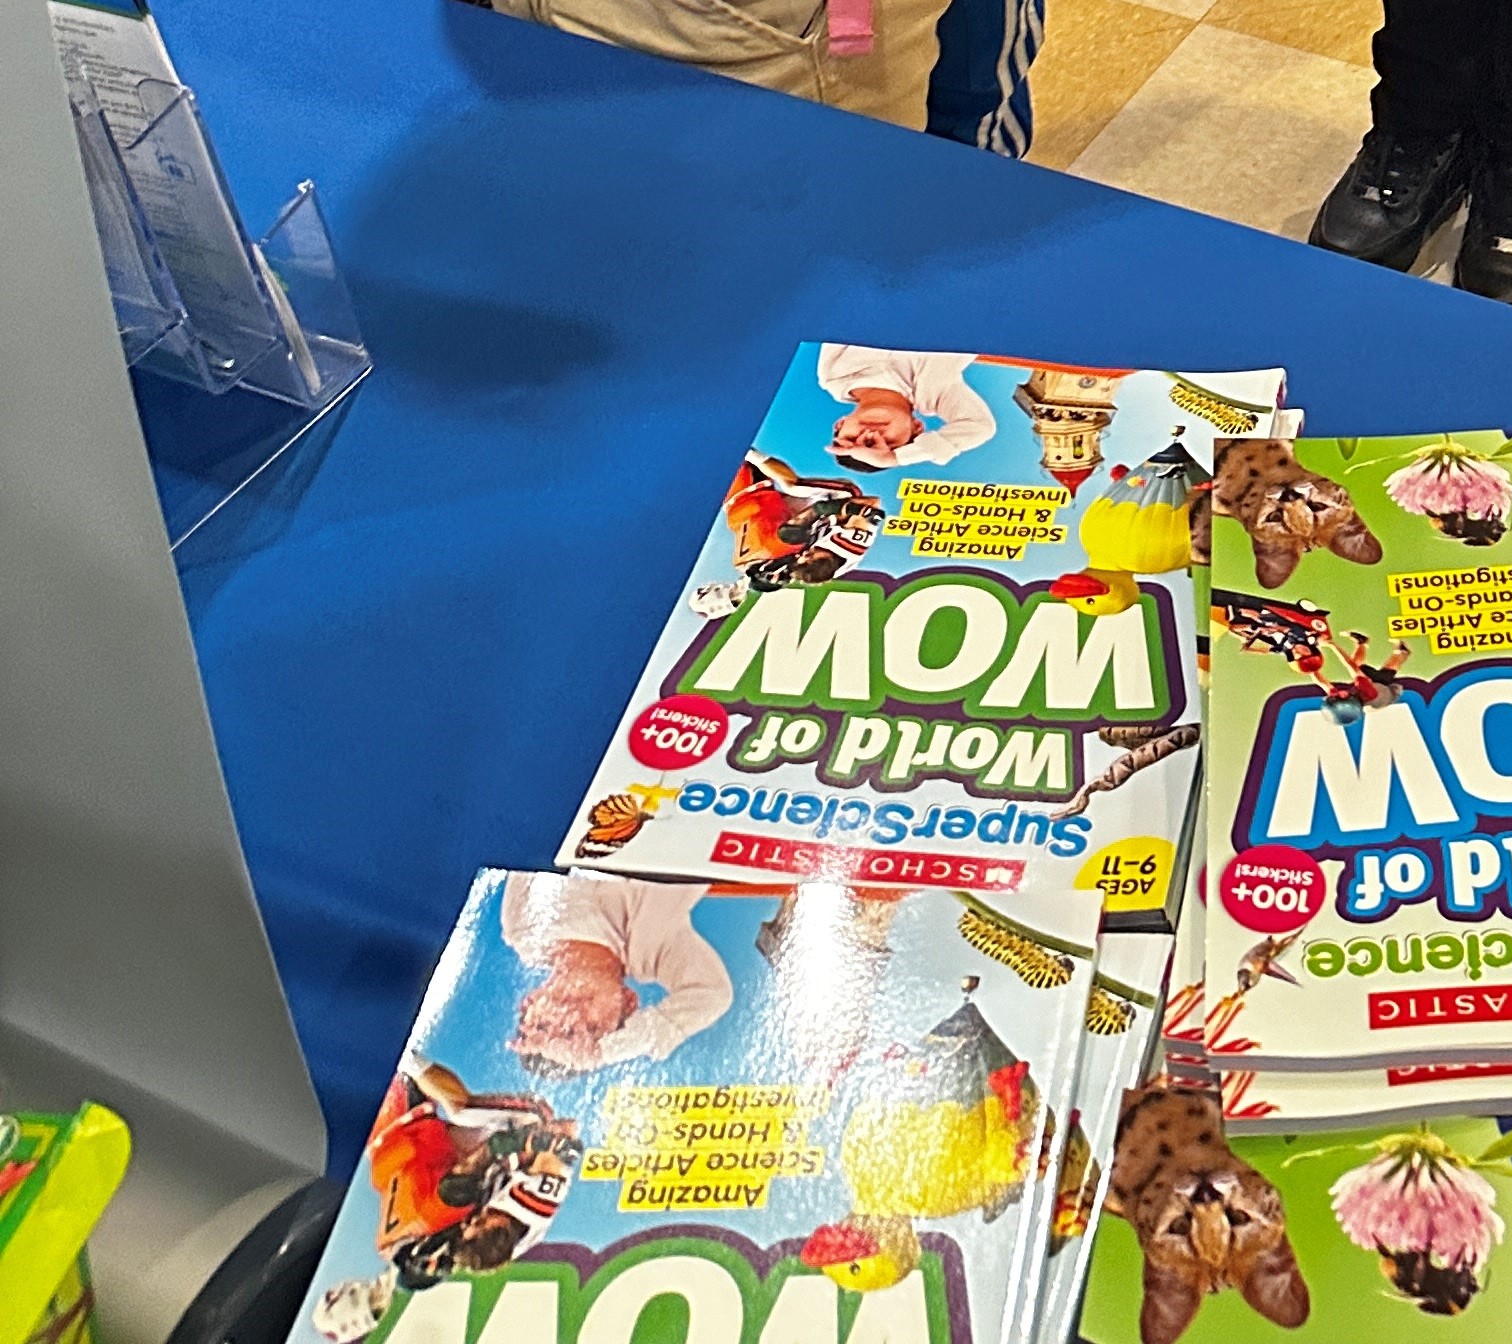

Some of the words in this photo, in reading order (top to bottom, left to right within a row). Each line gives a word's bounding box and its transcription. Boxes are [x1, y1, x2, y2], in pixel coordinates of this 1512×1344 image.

[902, 481, 1068, 505] Investigations!
[908, 501, 1027, 523] Hands-On
[1033, 508, 1053, 523] &
[886, 517, 972, 537] Articles
[976, 522, 1064, 543] Science
[917, 536, 1023, 561] Amazing
[1390, 612, 1483, 634] Articles
[693, 584, 1155, 710] WOW
[649, 706, 721, 734] Stickers!
[638, 724, 706, 757] 100+
[742, 715, 821, 762] of
[832, 716, 1066, 789] World
[721, 839, 979, 881] SCHOSTIC
[1095, 877, 1156, 895] AGES
[1235, 862, 1314, 887] Stickers!
[1355, 853, 1426, 910] of
[1231, 880, 1310, 914] 100+
[585, 1153, 699, 1179] Articles
[705, 1151, 820, 1174] Science
[626, 1179, 765, 1211] Amazing
